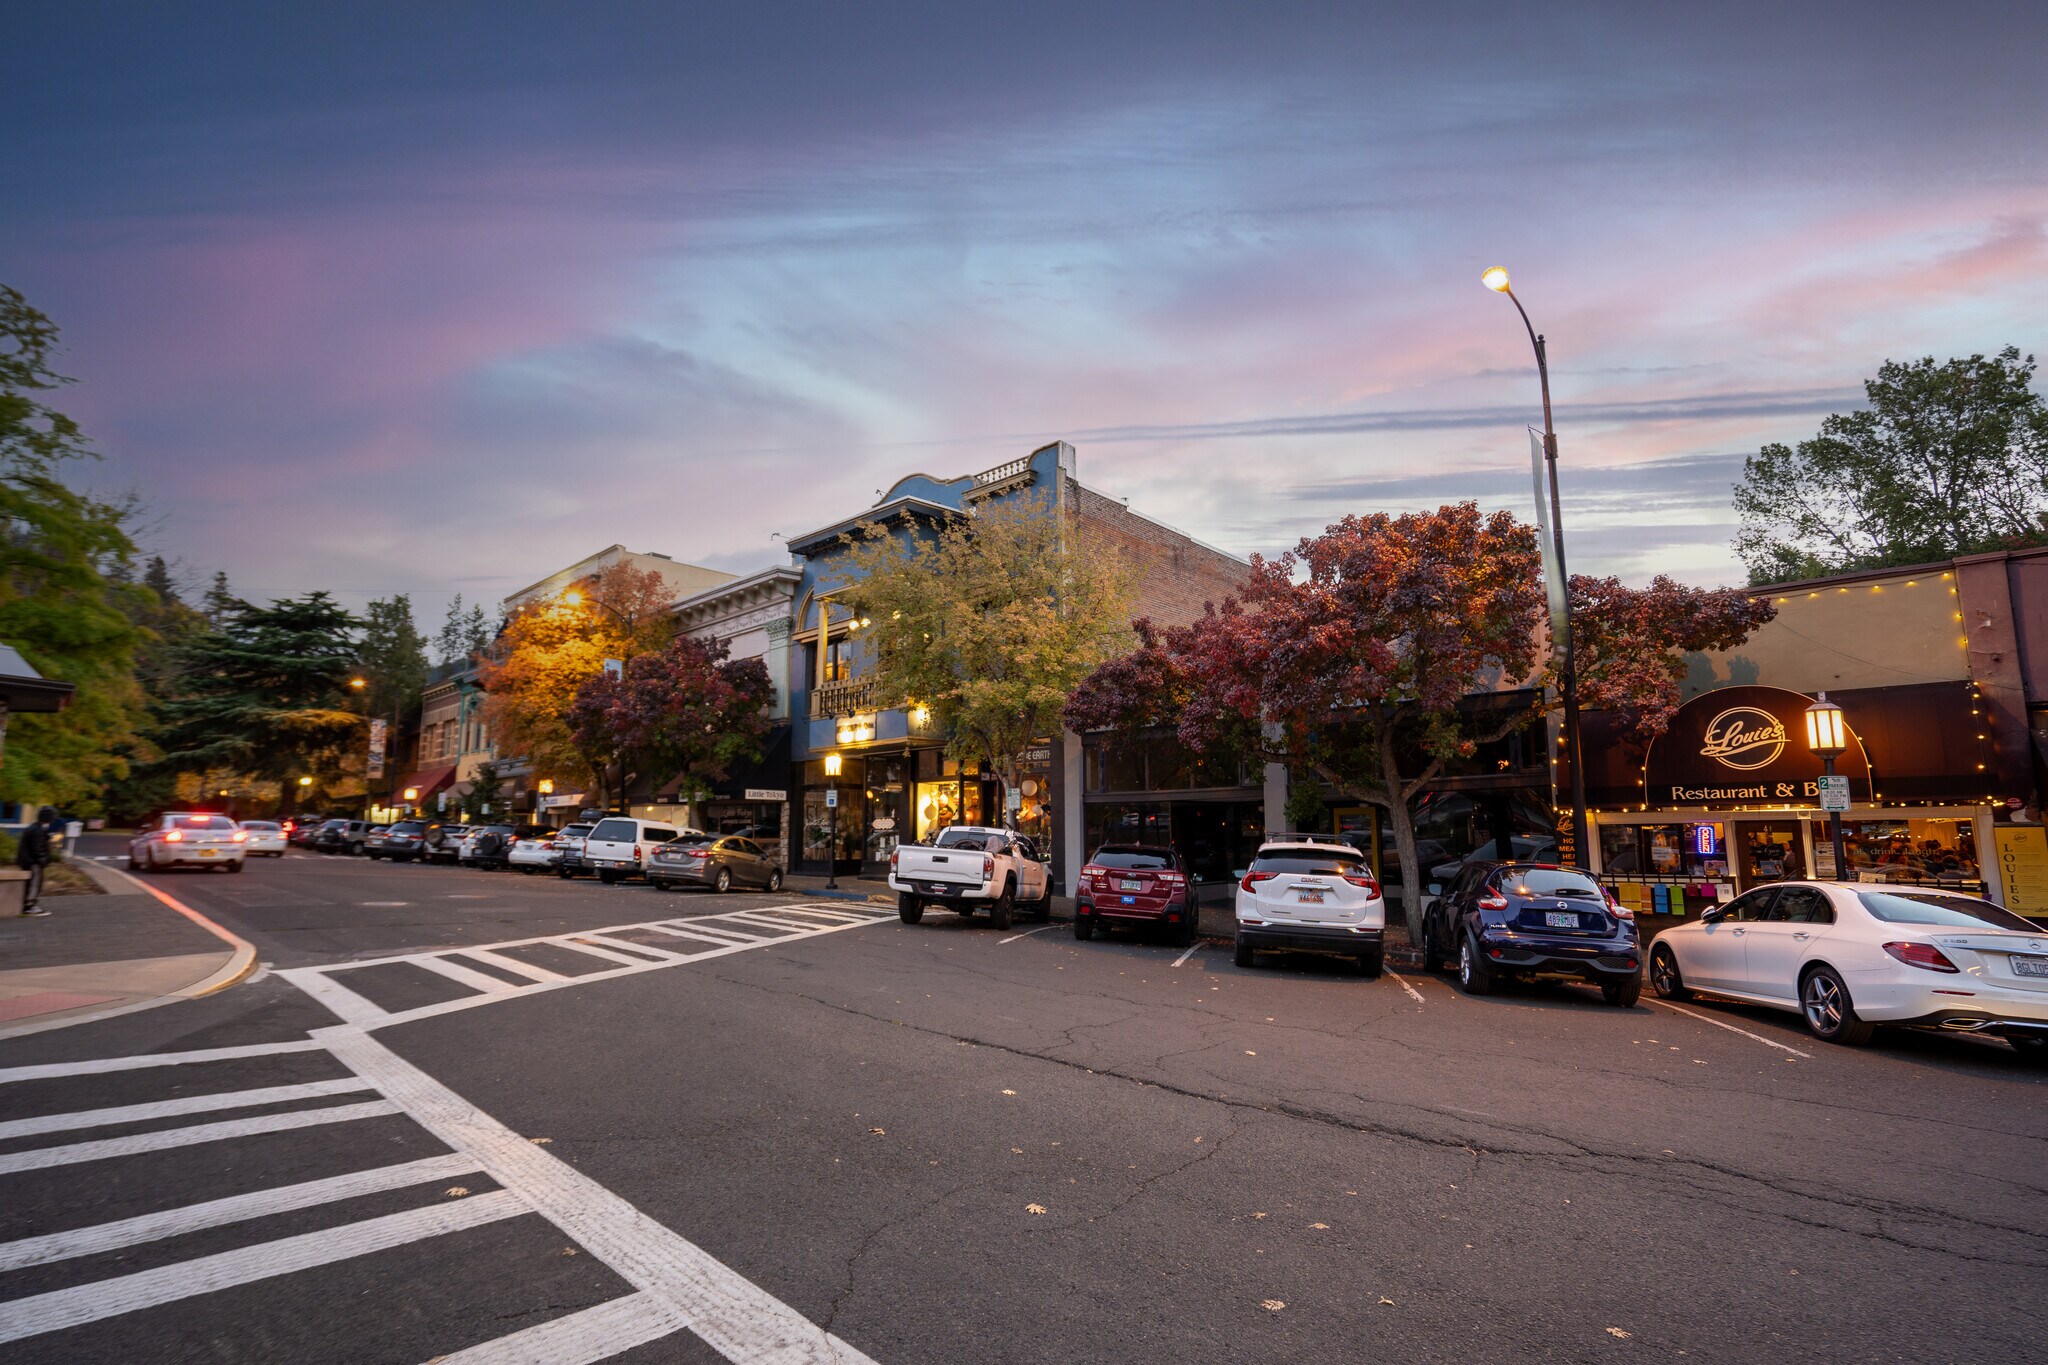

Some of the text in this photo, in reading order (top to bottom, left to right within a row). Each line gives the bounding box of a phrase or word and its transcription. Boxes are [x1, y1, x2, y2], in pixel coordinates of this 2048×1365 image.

[1700, 719, 1790, 757] Louie's
[1671, 785, 1767, 800] Restaurant
[1775, 782, 1795, 797] &
[1820, 779, 1828, 788] 2
[748, 790, 784, 800] Little Tokyo
[1702, 828, 1710, 852] OPEN
[2003, 844, 2020, 904] LOUIES
